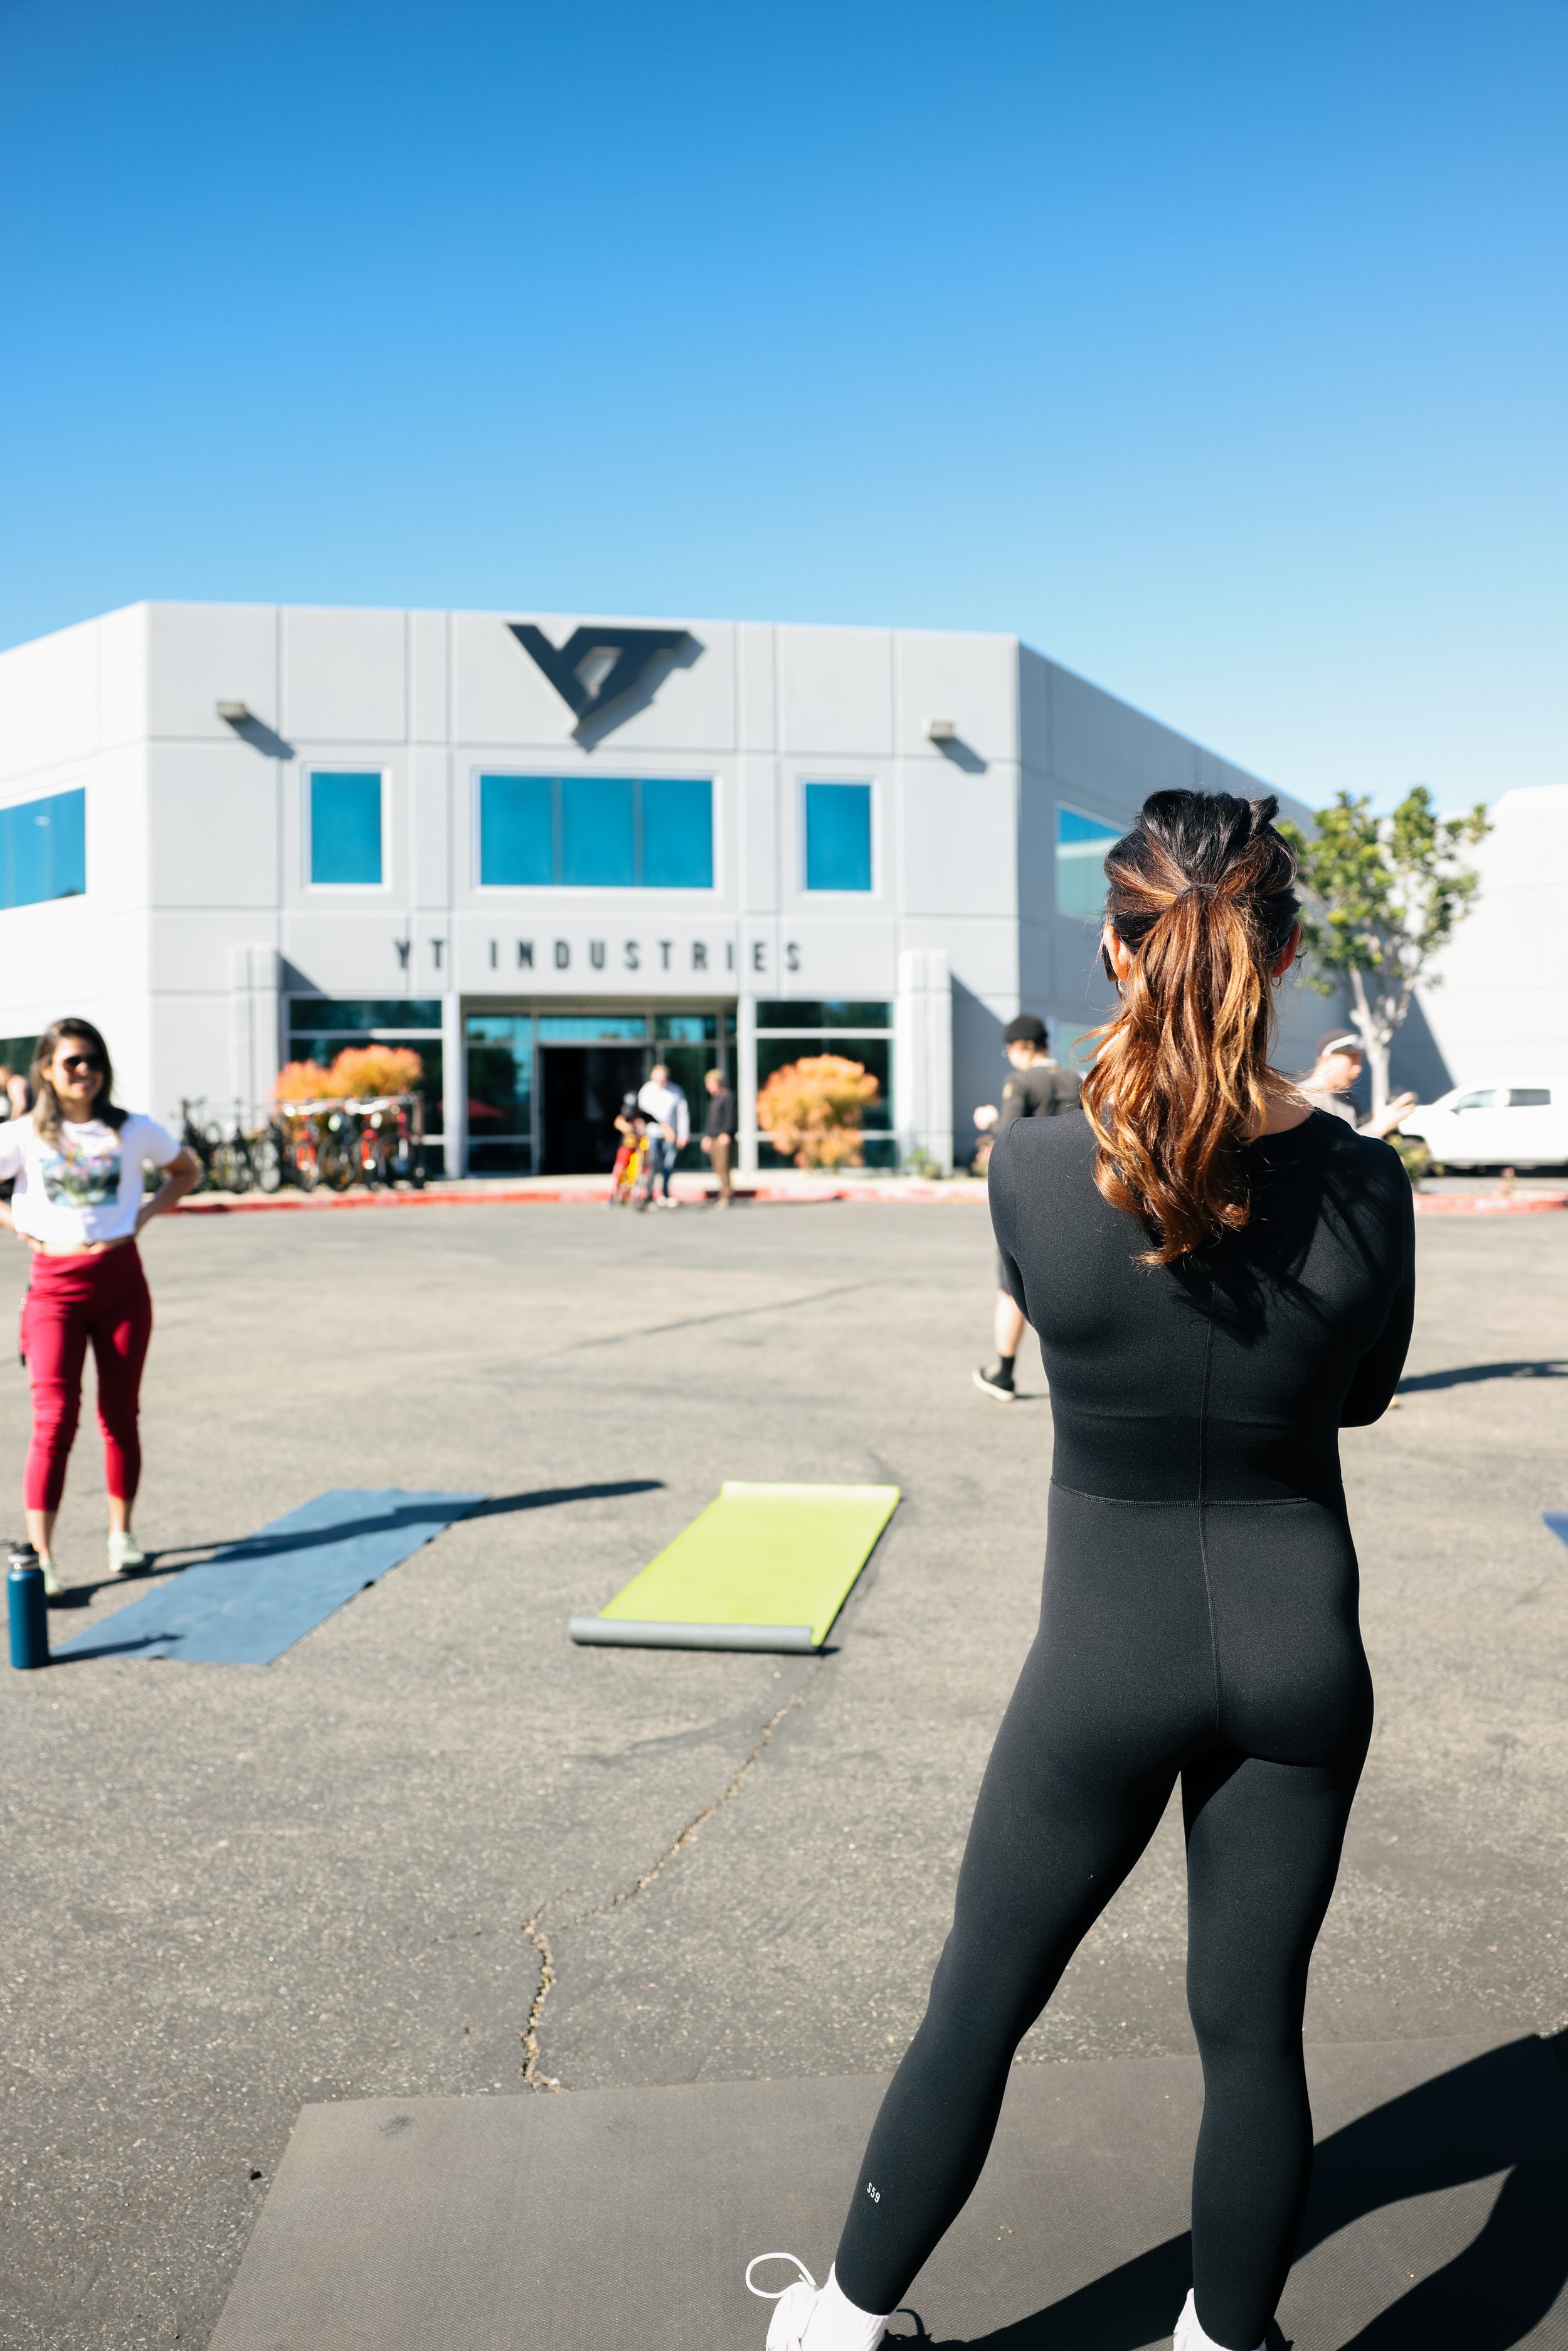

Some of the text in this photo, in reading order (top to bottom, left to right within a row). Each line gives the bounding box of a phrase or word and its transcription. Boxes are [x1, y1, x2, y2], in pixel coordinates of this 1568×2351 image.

[396, 939, 801, 972] YT INDUSTRIES
[867, 2182, 881, 2203] S59
